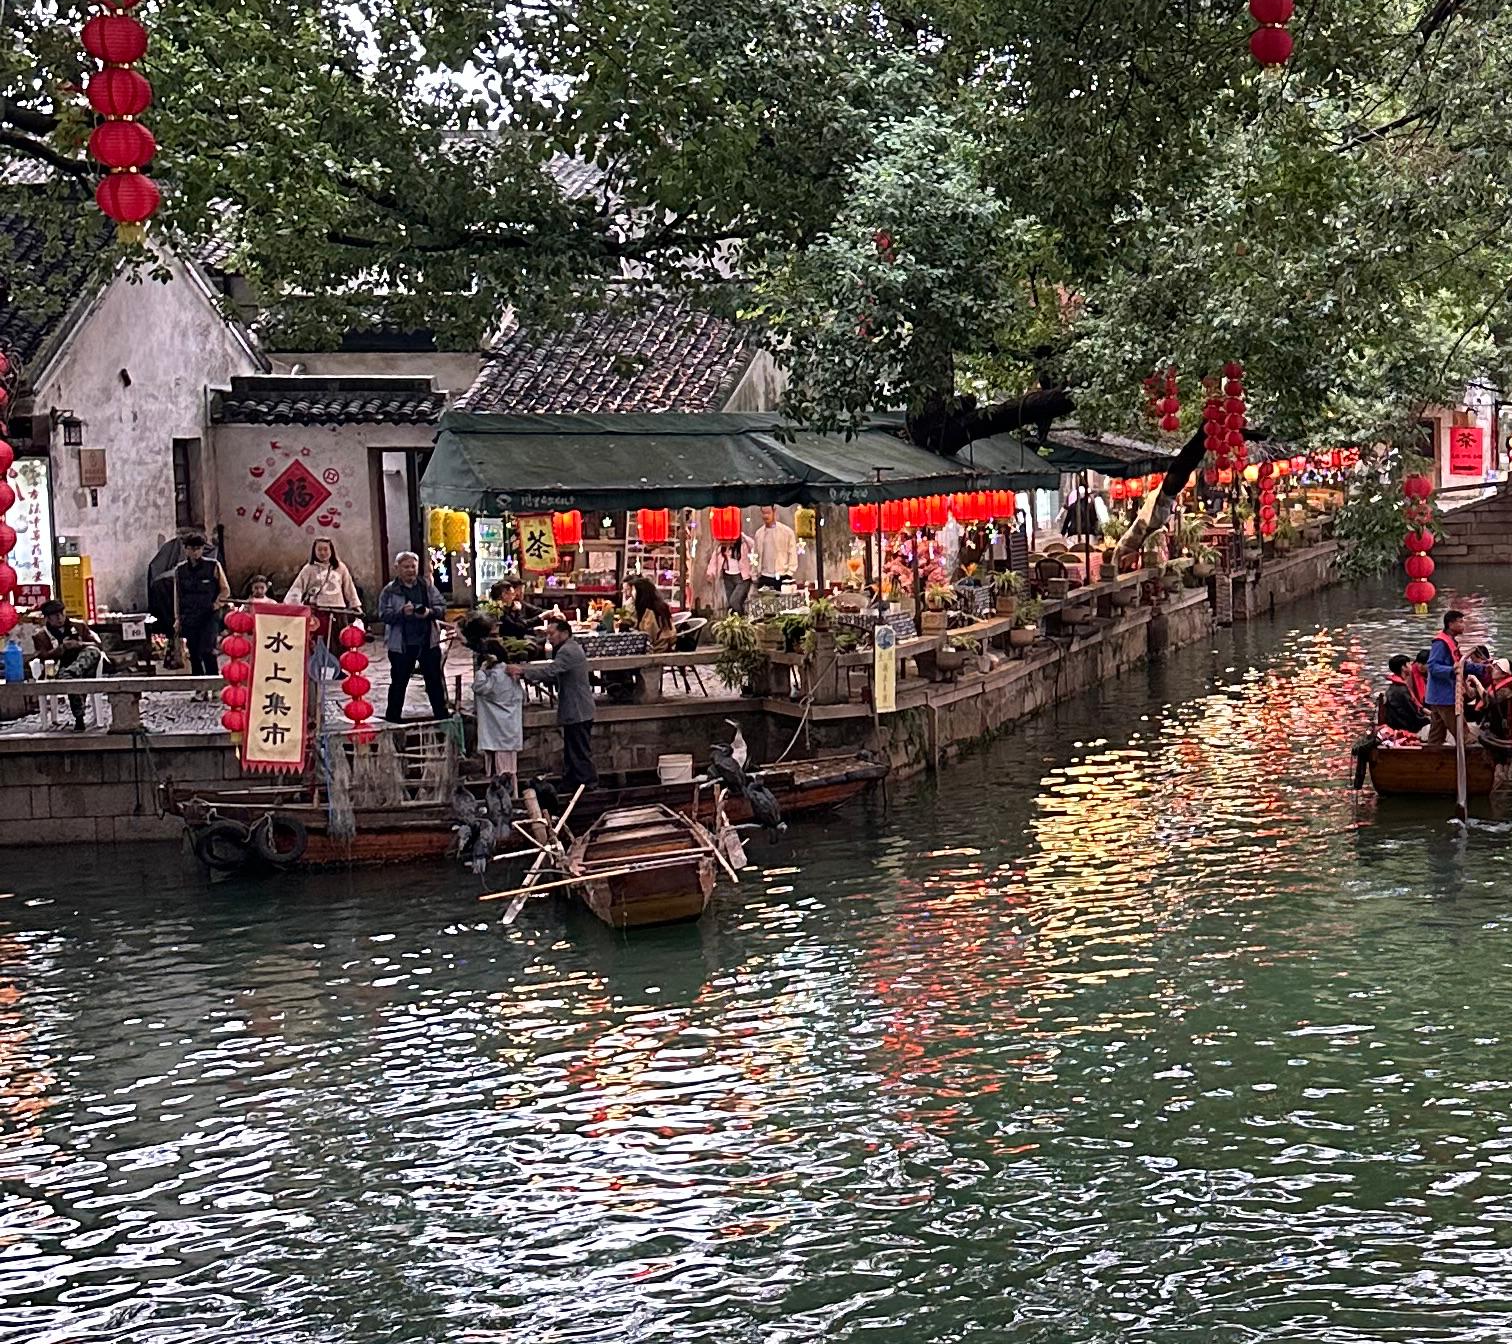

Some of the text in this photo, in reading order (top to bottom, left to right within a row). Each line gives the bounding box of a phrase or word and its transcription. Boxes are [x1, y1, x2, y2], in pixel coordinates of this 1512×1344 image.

[282, 477, 314, 509] 福
[526, 529, 553, 560] 茶
[259, 631, 294, 746] 水上集市
